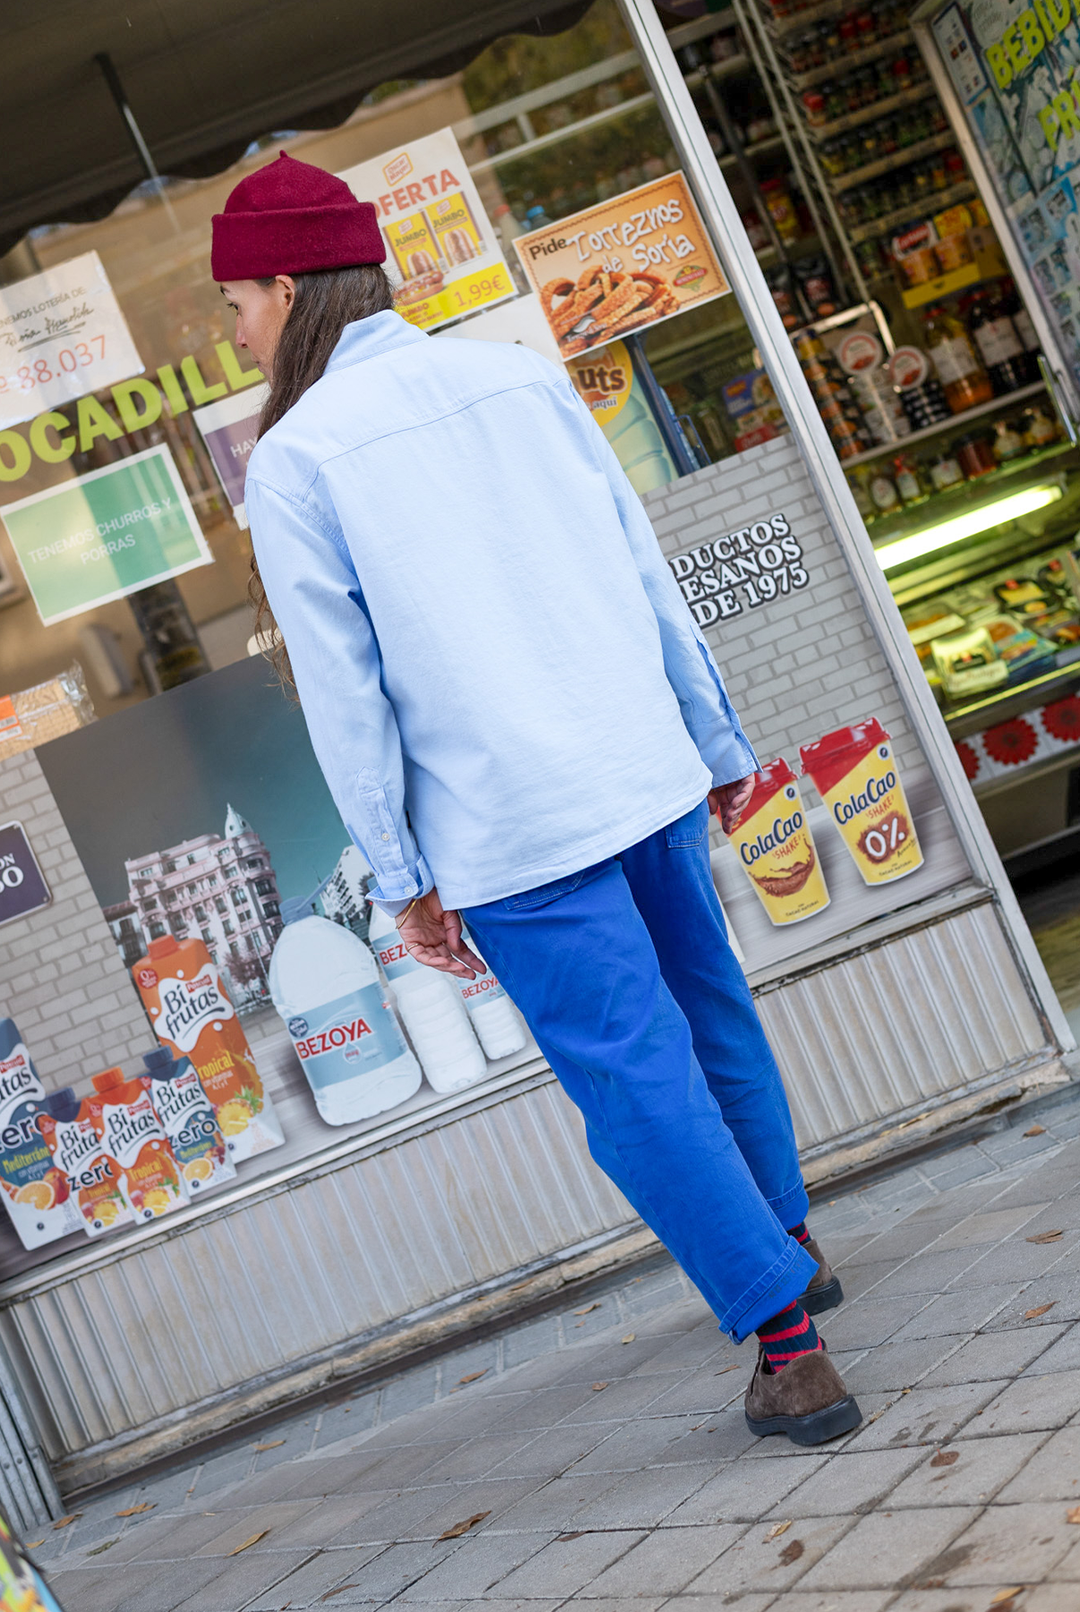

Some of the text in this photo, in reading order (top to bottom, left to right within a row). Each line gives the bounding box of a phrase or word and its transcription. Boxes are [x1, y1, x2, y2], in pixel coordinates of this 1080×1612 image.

[986, 0, 1080, 89] BEBID
[394, 228, 427, 248] JUMBO
[433, 208, 465, 228] JUMBO
[567, 198, 684, 262] Torreznos
[529, 237, 568, 260] Pide
[602, 254, 624, 273] de
[0, 308, 32, 328] NEMOS
[71, 286, 88, 298] DE
[454, 274, 506, 308] 1,99€
[17, 334, 107, 390] 88.037
[0, 340, 266, 482] OCADILL
[28, 498, 172, 564] TENEMOS CHURROS Y
[80, 534, 136, 565] PORRAS
[669, 513, 791, 580] DUCTOS
[679, 535, 803, 603] ESANOS
[691, 561, 809, 629] DE 1975
[833, 771, 897, 825] ColaCao
[740, 811, 804, 866] ColaCao
[864, 817, 906, 857] 0%
[380, 943, 409, 966] BEZ
[186, 975, 213, 992] Pascual
[165, 986, 219, 1040] frutas
[295, 1018, 373, 1060] BEZOYA
[158, 1083, 201, 1128] frutas
[0, 1112, 46, 1153] er
[109, 1110, 155, 1157] frutas
[168, 1120, 216, 1149] zero
